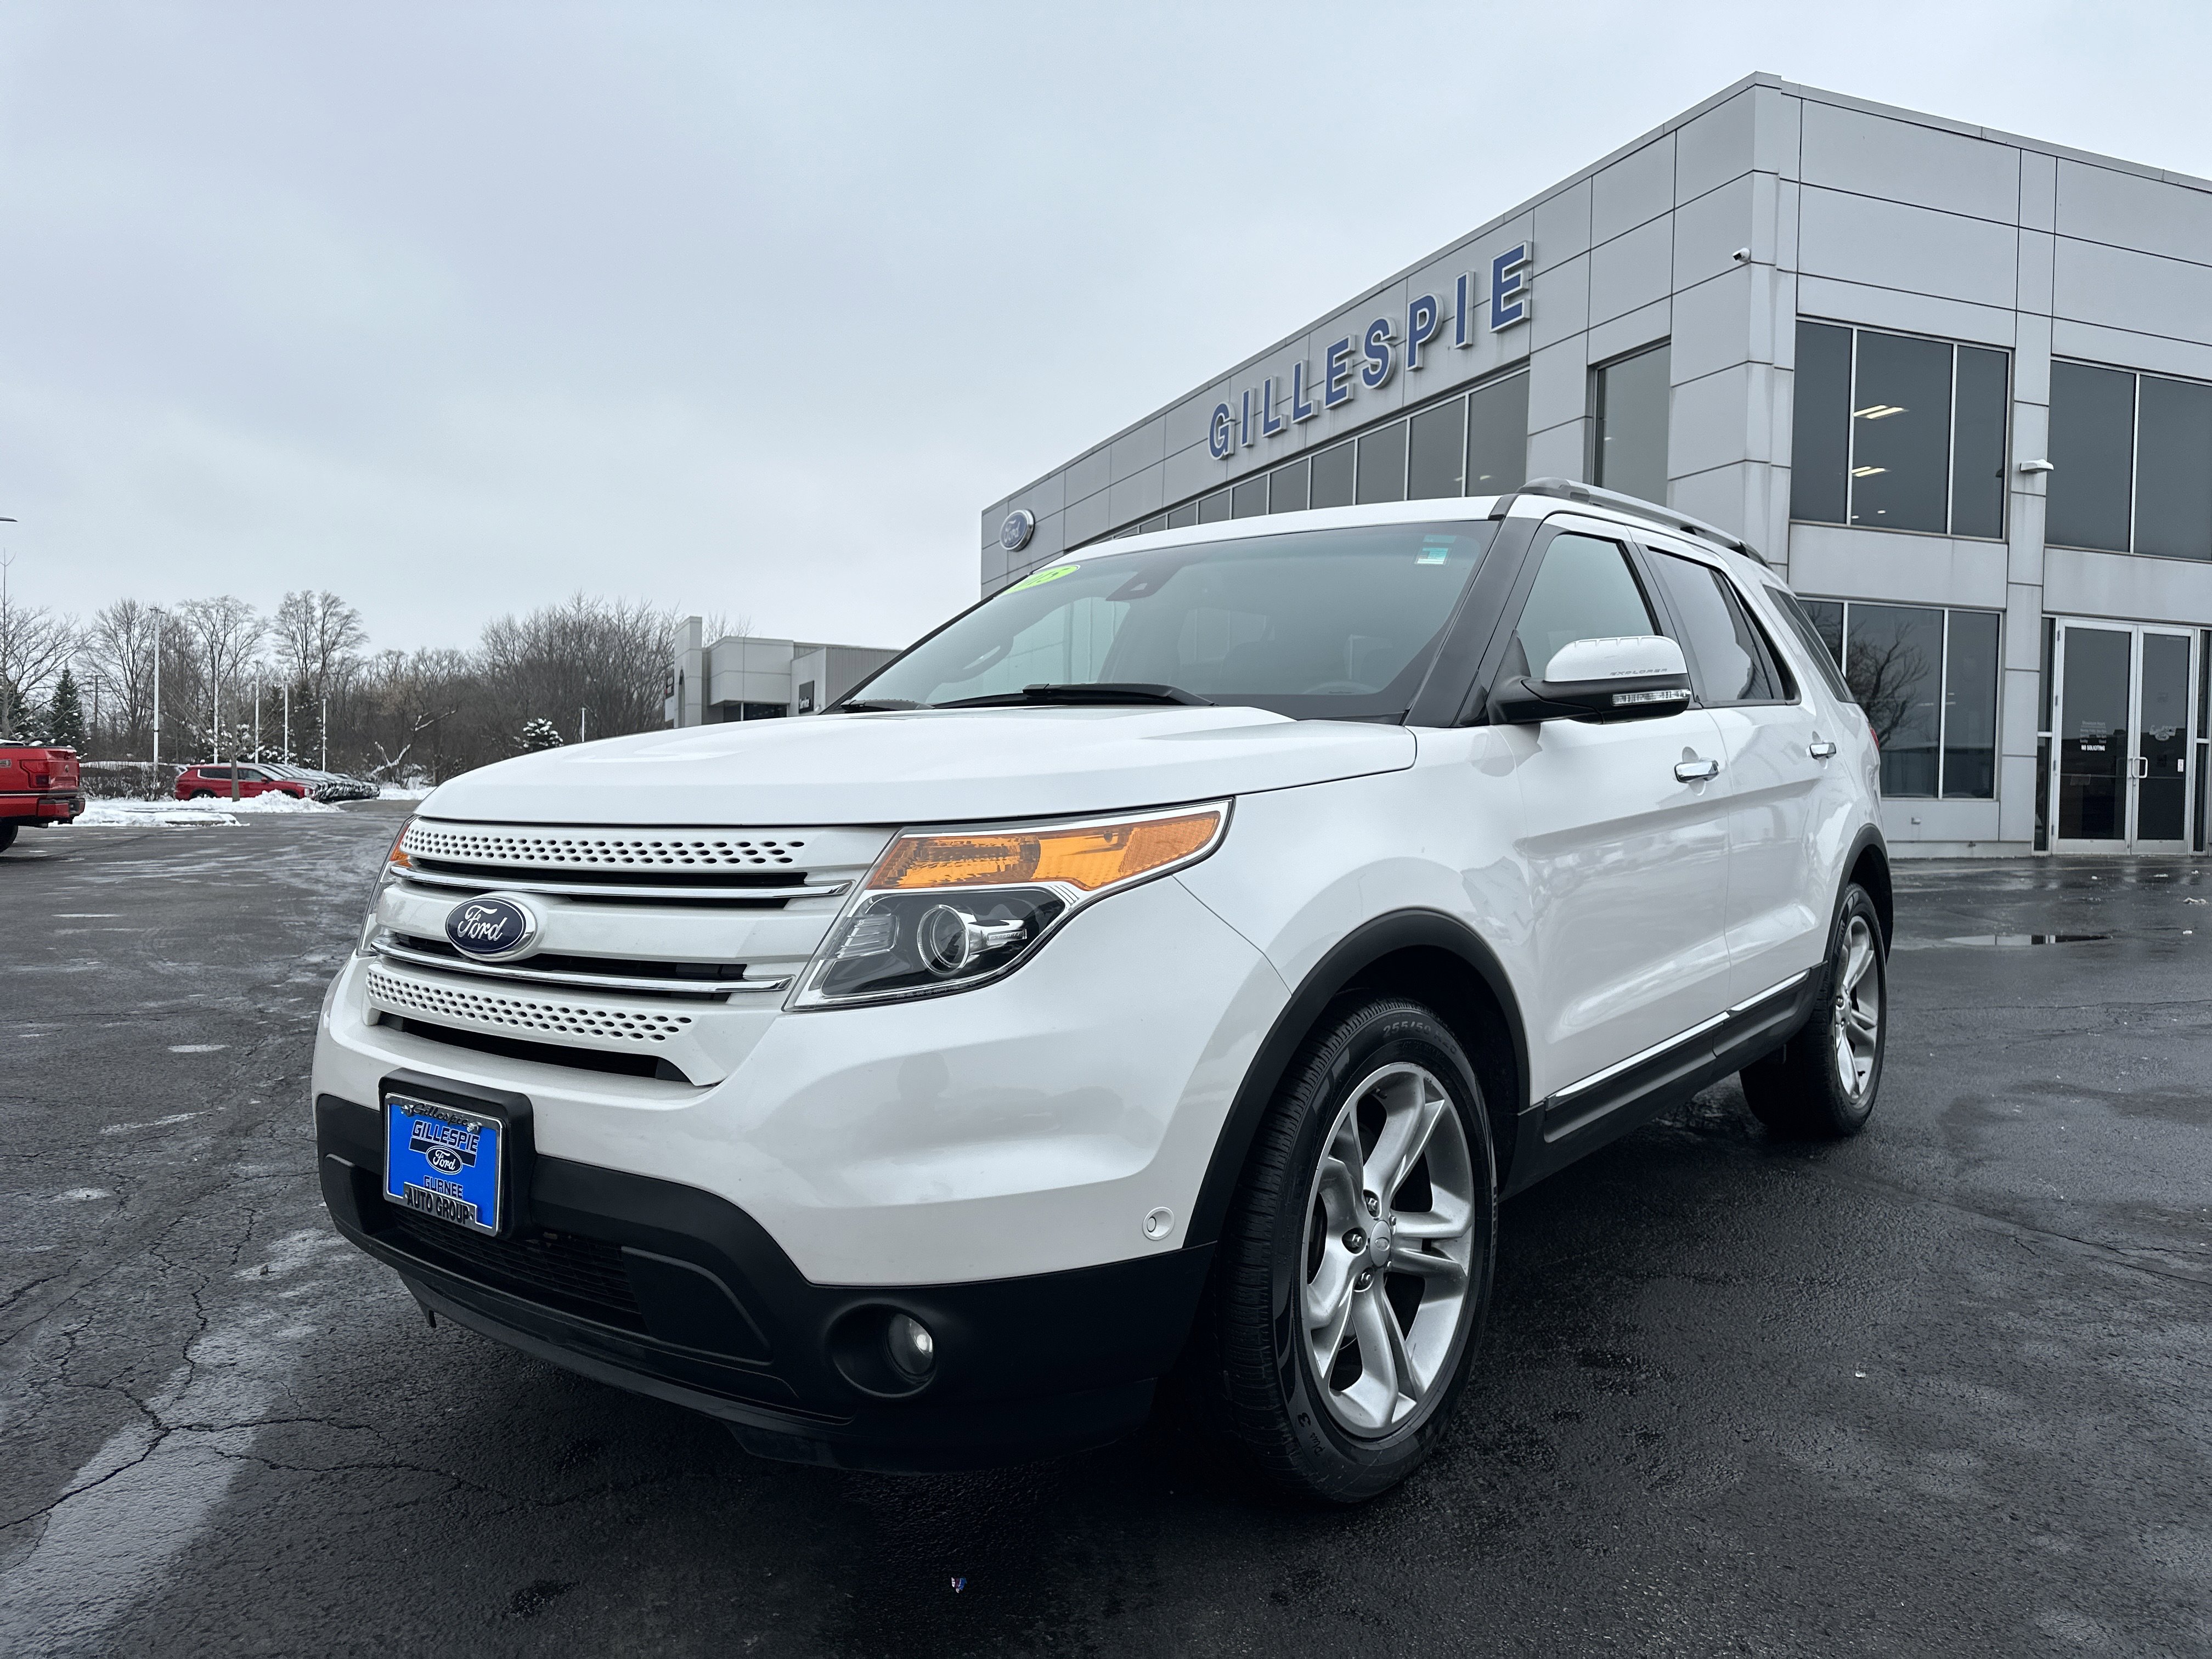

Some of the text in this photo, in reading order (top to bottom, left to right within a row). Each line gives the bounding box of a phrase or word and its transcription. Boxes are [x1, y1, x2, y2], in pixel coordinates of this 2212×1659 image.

[1208, 240, 1532, 460] GILLESPIE
[1004, 518, 1021, 542] Ford
[457, 905, 508, 941] Ford
[1382, 1020, 1431, 1039] 255/50
[412, 1103, 469, 1126] Gillespie
[412, 1120, 480, 1153] GILLESPIE
[432, 1149, 456, 1171] Ford
[423, 1175, 464, 1200] GURNEE
[407, 1187, 470, 1225] AUTO GROUP
[1297, 1412, 1312, 1428] 3
